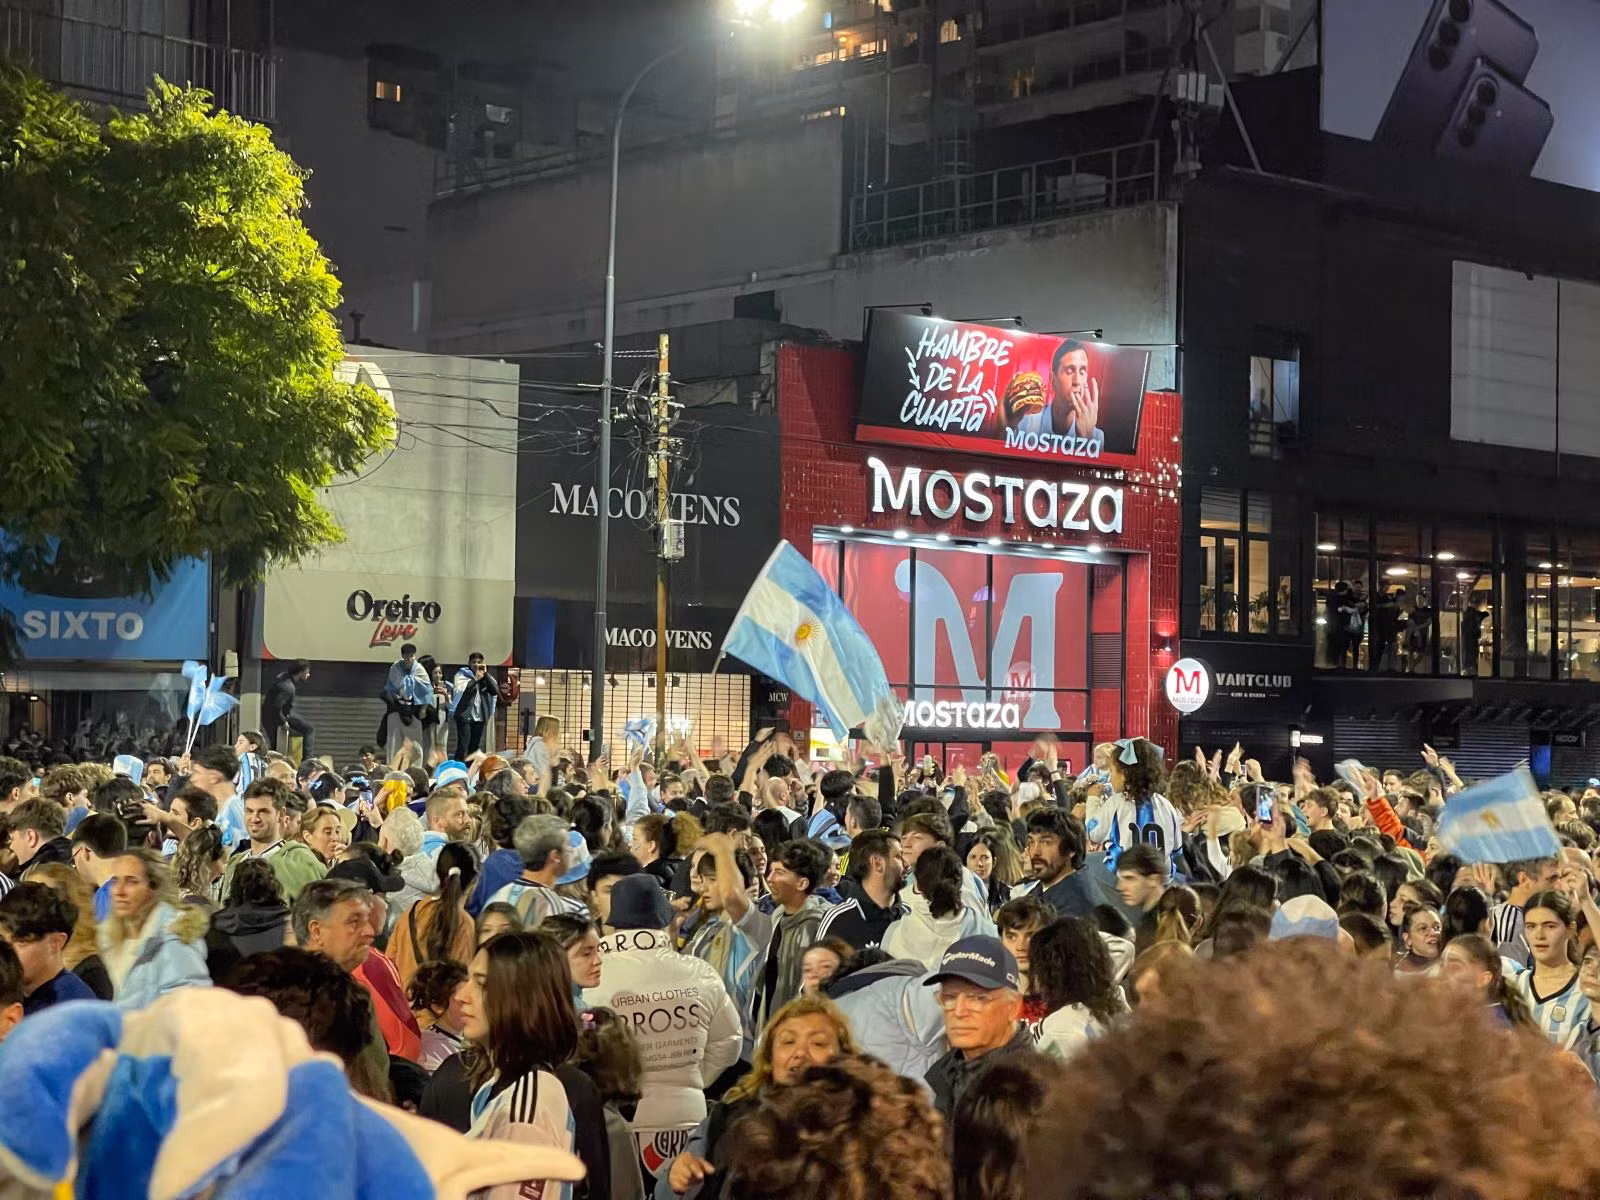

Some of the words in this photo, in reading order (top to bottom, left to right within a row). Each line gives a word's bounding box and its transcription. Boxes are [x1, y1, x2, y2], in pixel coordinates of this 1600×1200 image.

[915, 325, 1014, 367] HAMBRE
[923, 362, 957, 393] DE
[956, 364, 985, 395] LA
[346, 589, 442, 625] Oreiro
[22, 610, 144, 641] SIXTO
[369, 615, 419, 648] Love
[1215, 672, 1293, 688] VANTCLUB
[611, 993, 650, 1009] URBAN
[652, 987, 699, 1002] CLOTHES
[618, 1003, 700, 1036] ROSS
